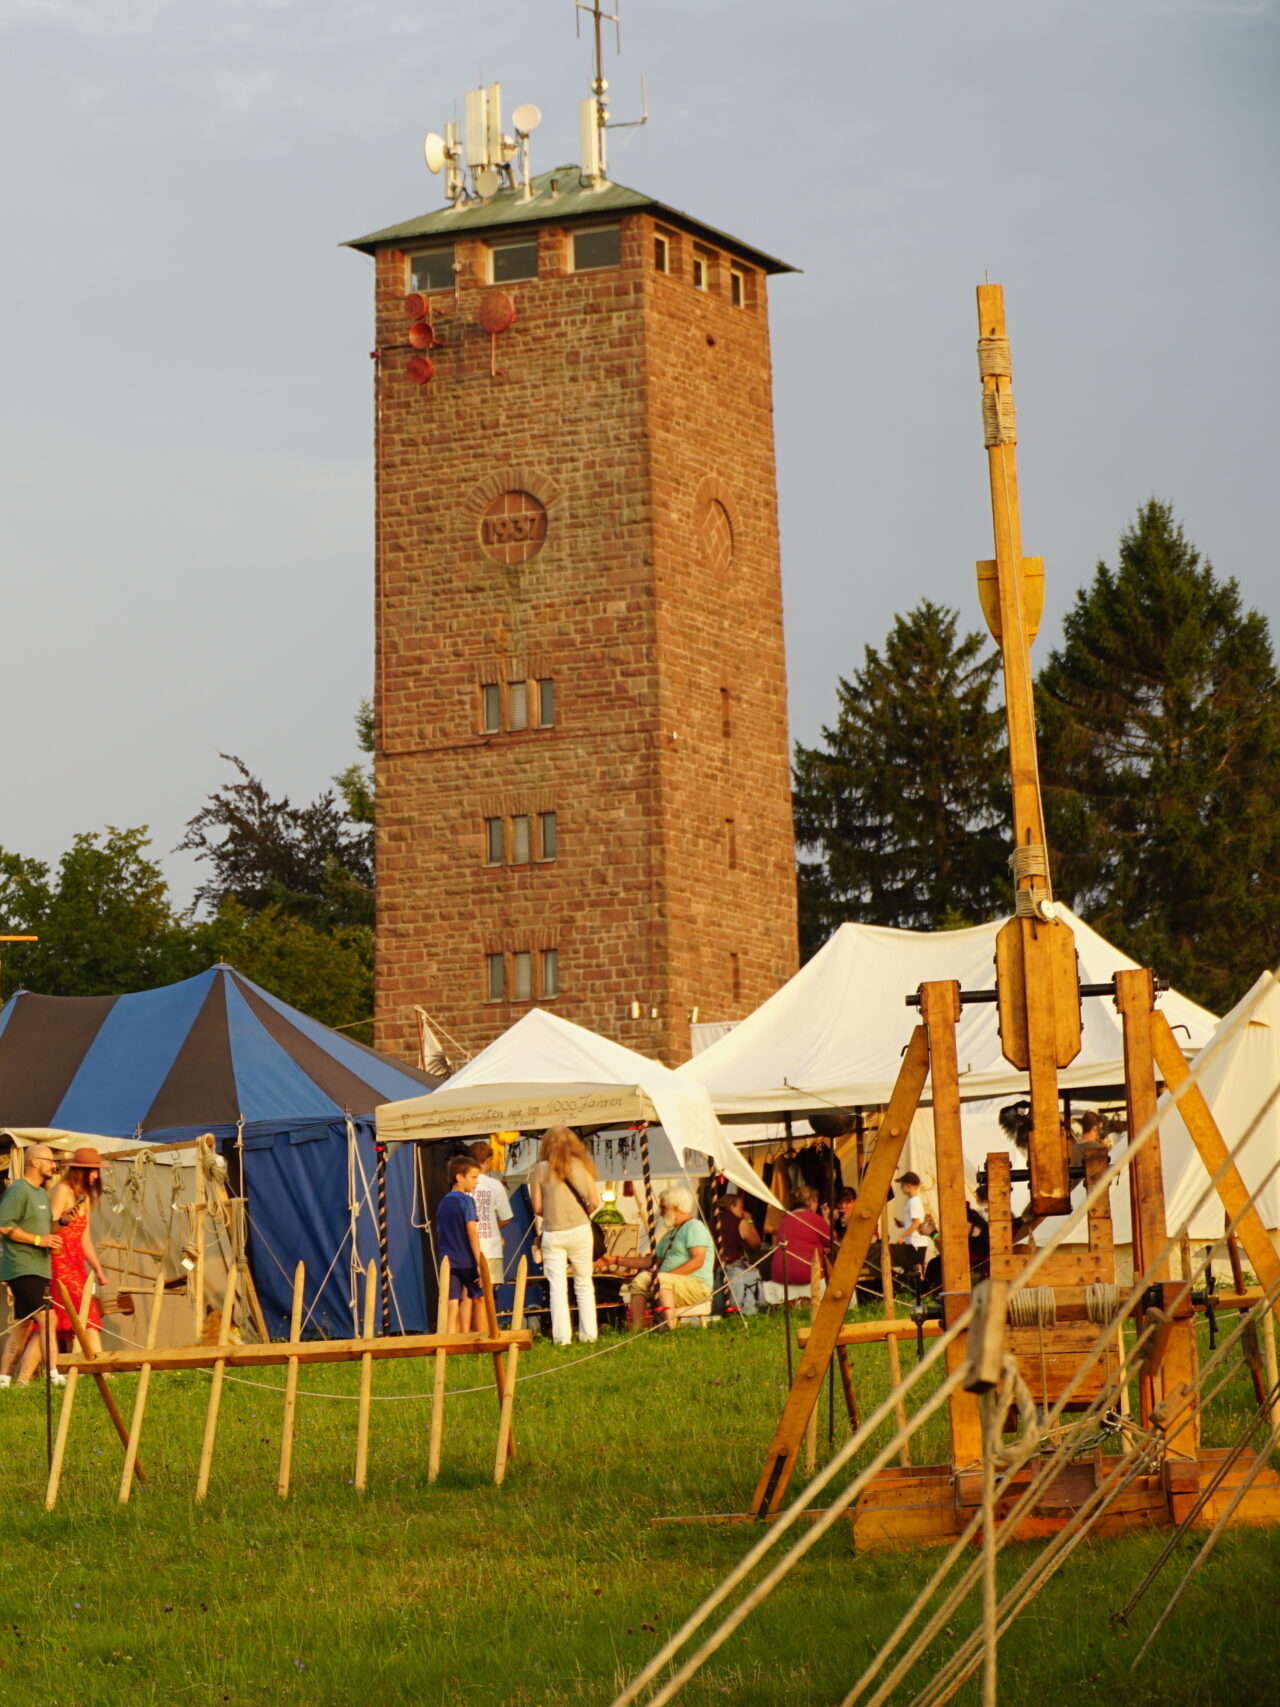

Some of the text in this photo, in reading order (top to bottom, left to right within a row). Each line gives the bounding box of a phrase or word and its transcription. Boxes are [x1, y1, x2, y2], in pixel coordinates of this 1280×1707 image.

[483, 513, 543, 546] 1937
[547, 1099, 577, 1113] 1000
[578, 1094, 623, 1112] Jahren
